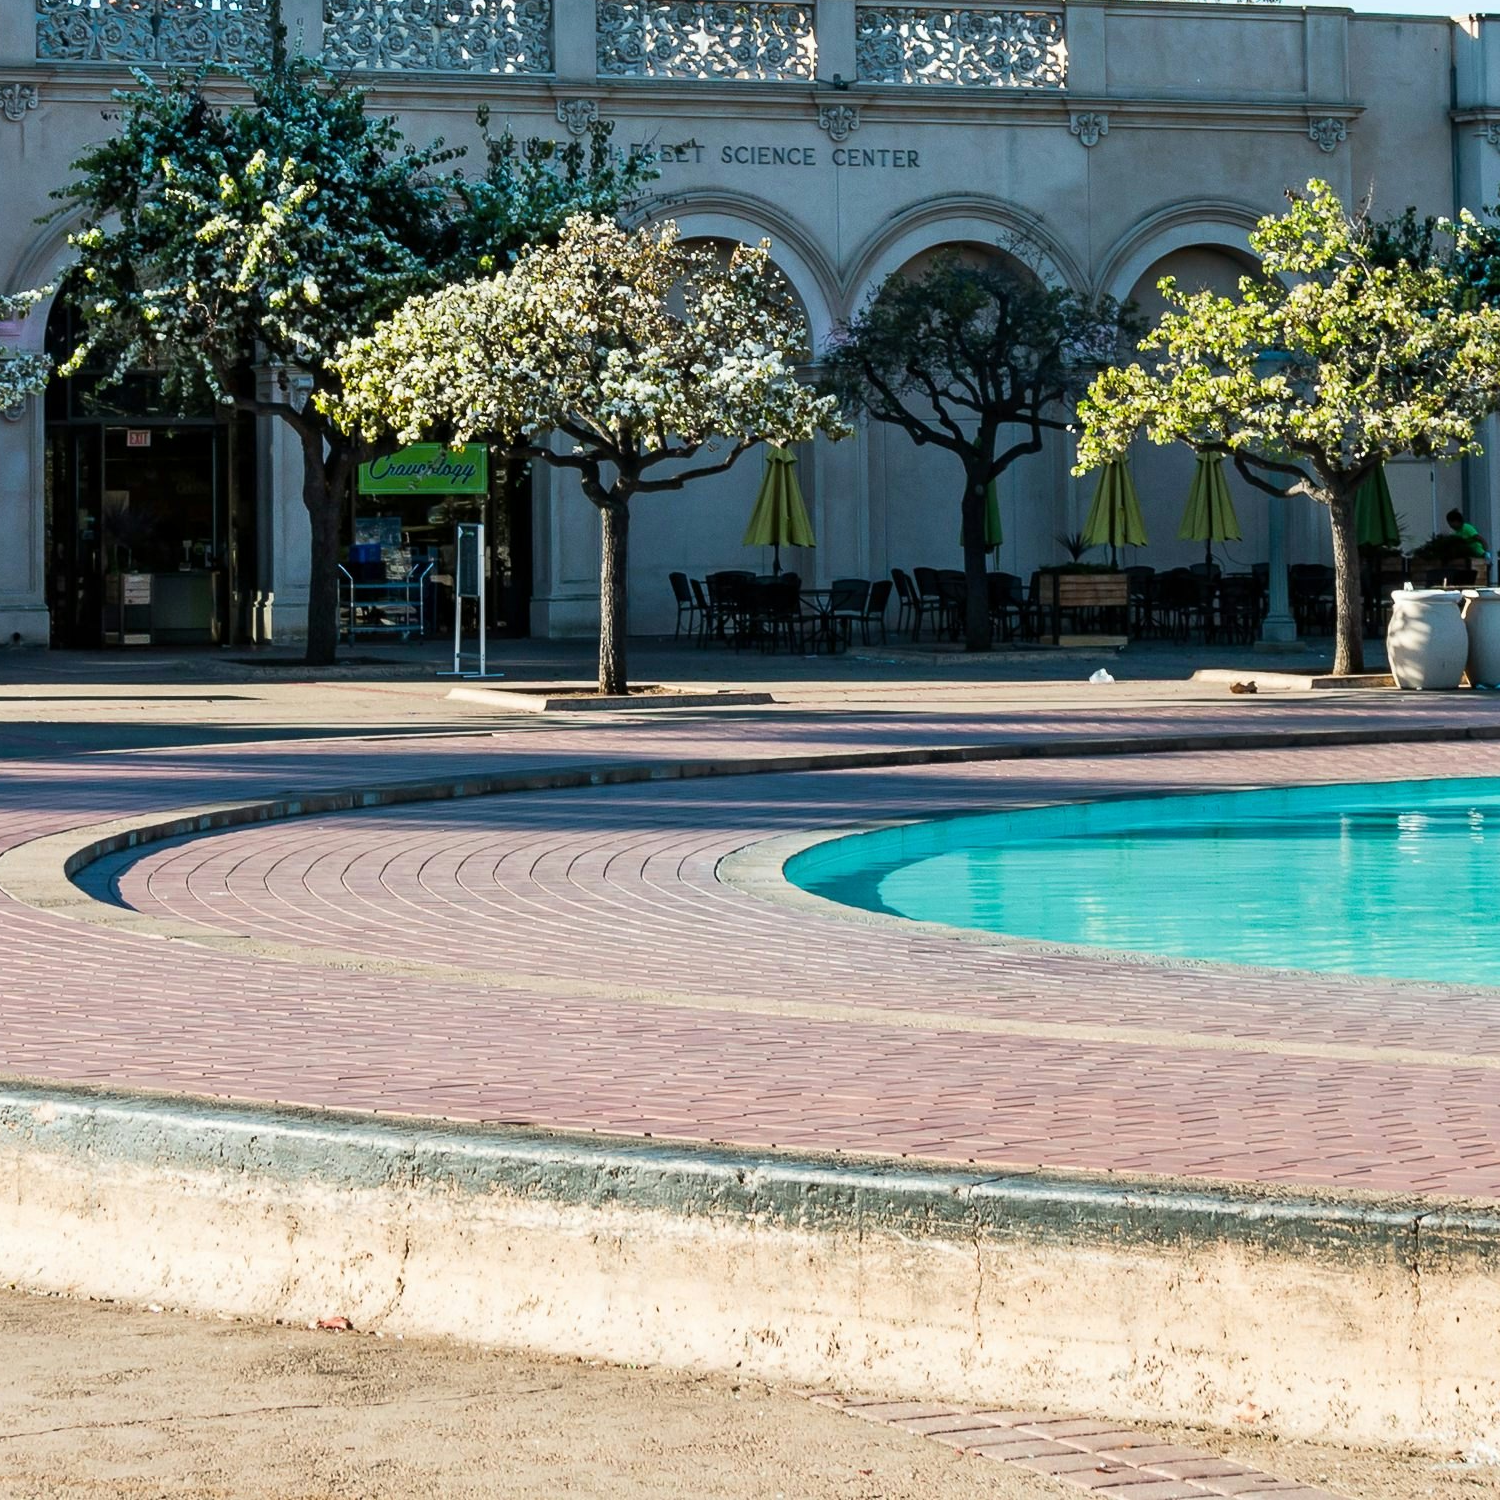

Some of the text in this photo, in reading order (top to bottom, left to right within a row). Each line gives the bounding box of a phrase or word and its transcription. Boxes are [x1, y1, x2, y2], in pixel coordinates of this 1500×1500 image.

[721, 145, 816, 166] SCIENCE
[832, 149, 920, 167] CENTER
[130, 432, 149, 445] EXIT
